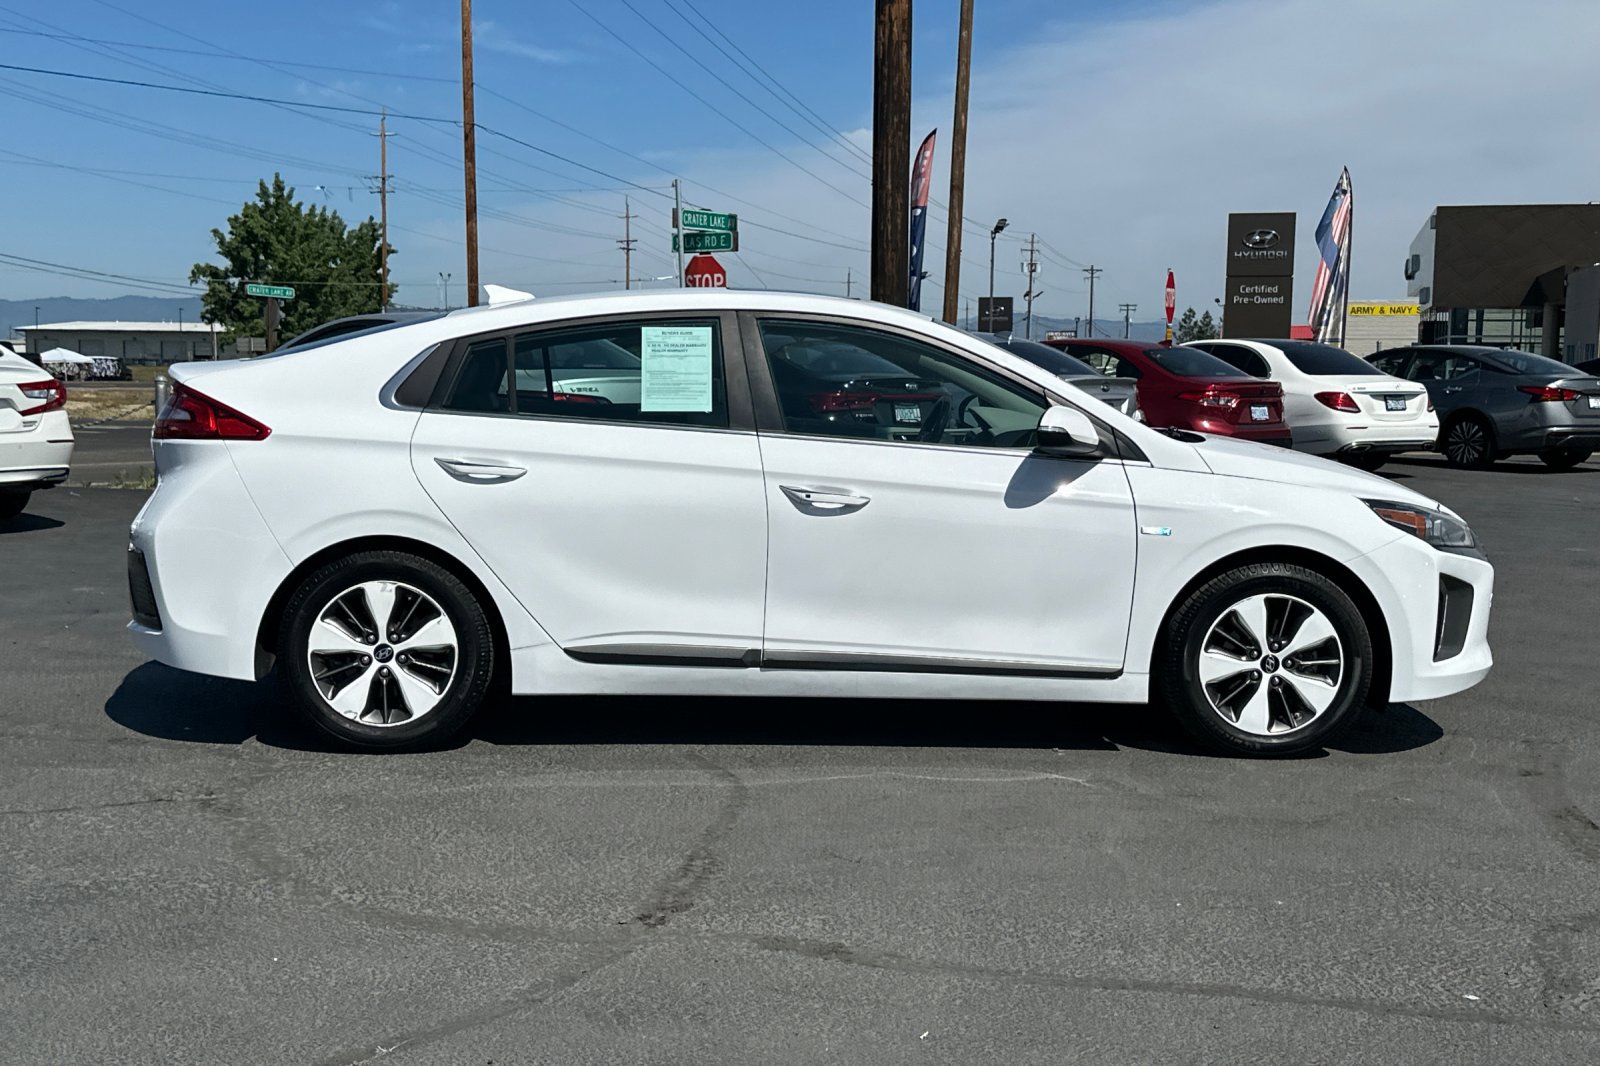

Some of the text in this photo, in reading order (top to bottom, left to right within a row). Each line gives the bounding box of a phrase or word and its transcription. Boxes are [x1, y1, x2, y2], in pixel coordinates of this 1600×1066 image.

[683, 213, 708, 226] CRATER
[709, 215, 726, 228] LAKE
[704, 235, 717, 247] RD
[720, 235, 726, 246] E
[1234, 250, 1288, 260] HYUNDAI
[686, 273, 724, 288] STOP
[1239, 284, 1279, 293] Certified
[1233, 295, 1284, 304] Pre-Owned
[1350, 306, 1376, 315] ARMY
[1378, 306, 1385, 314] &
[1389, 306, 1413, 314] NAVY
